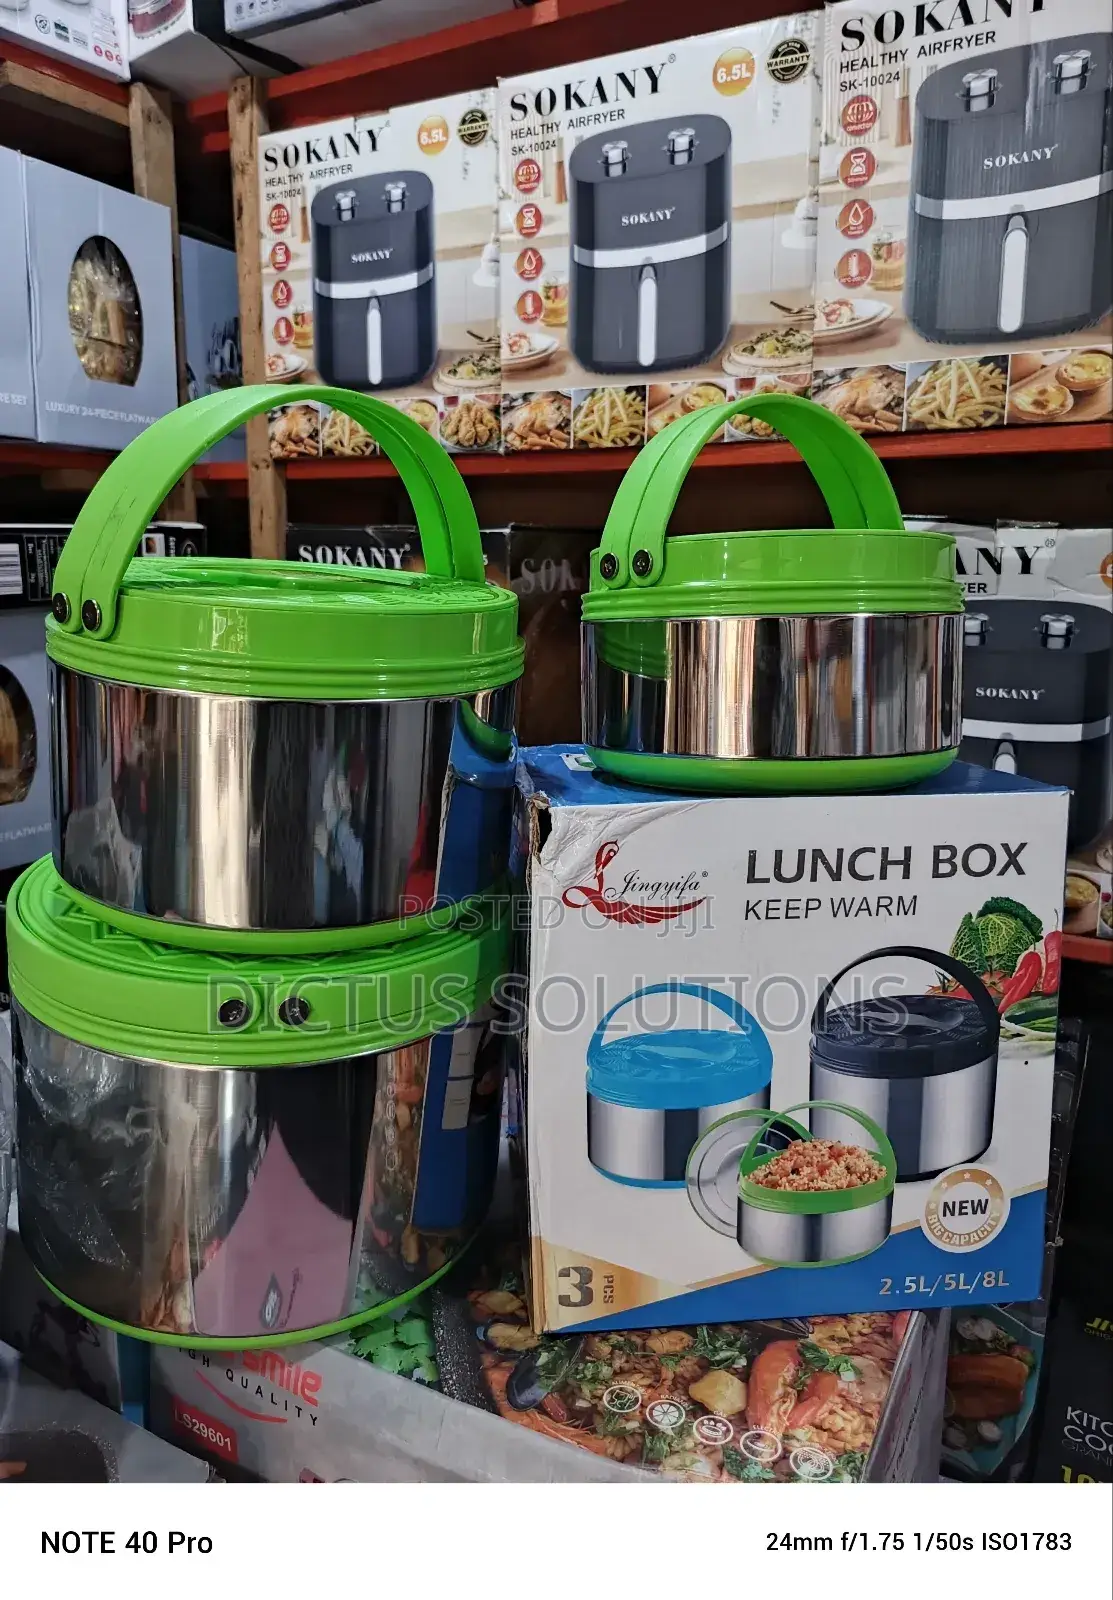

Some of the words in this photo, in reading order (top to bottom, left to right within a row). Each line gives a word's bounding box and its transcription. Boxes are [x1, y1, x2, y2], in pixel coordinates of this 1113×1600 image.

[766, 53, 811, 68] WARRANTY
[839, 48, 908, 74] HEALTHY
[917, 30, 996, 59] AIRFRYER
[716, 63, 752, 84] 6.5L
[839, 71, 901, 93] SK-10024
[510, 62, 668, 122] SOKANY
[420, 127, 447, 146] 6.5L
[510, 120, 561, 140] HEALTHY
[567, 108, 626, 131] AIRFRYER
[264, 127, 385, 173] SOKANY
[511, 139, 557, 157] SK-10024
[983, 147, 1056, 170] SOKANY
[265, 173, 304, 188] HEALTHY
[309, 163, 354, 180] AIRFRYER
[266, 188, 302, 202] SK-10024
[621, 208, 673, 227] SOKANY
[351, 249, 391, 264] SOKANY
[45, 400, 80, 415] LUXURY
[298, 544, 405, 570] SOKANY
[975, 686, 1041, 701] SOKANY
[746, 846, 913, 885] LUNCH
[931, 842, 1029, 879] BOX
[603, 869, 700, 901] Jingyifa
[744, 899, 822, 921] KEEP
[830, 894, 918, 919] WARM
[942, 1198, 990, 1218] NEW
[928, 1214, 945, 1236] BIG
[558, 1266, 594, 1308] 3
[603, 1274, 615, 1304] PCS
[878, 1270, 1010, 1297] 2.5L/5L/8L
[225, 1367, 318, 1427] QUALITY
[173, 1407, 233, 1452] LS29601
[1063, 1425, 1113, 1455] CO
